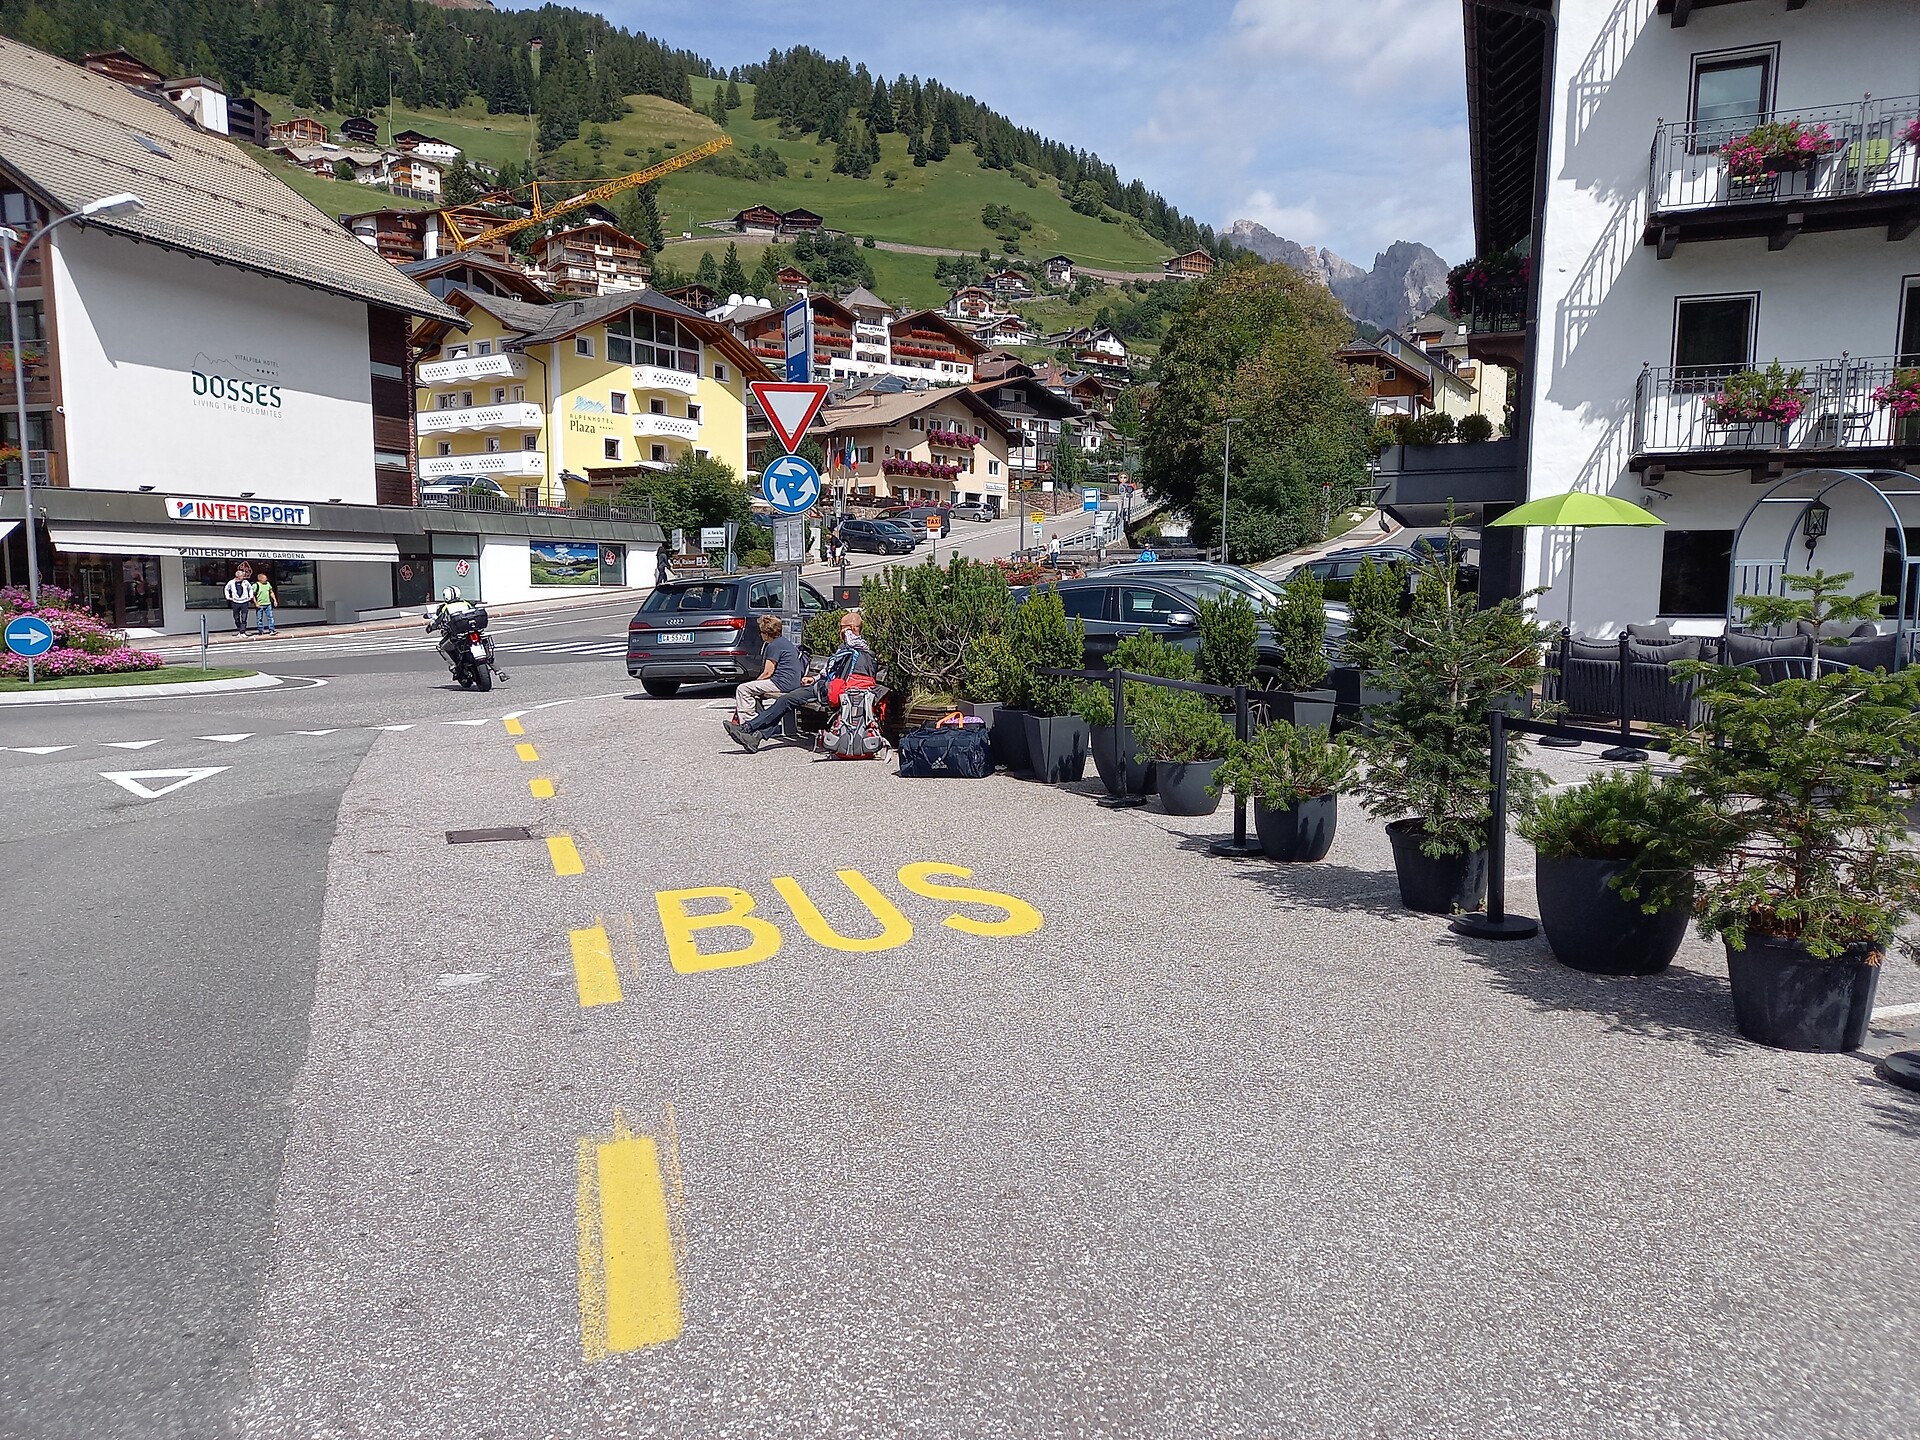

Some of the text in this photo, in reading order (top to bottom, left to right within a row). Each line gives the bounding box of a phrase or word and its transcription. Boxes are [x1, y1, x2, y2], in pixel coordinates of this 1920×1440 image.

[263, 360, 279, 368] HOTEL
[191, 370, 282, 408] DOSSES
[193, 399, 282, 418] LIVING THE DOLOMITES
[569, 413, 614, 424] ALPENHOTEL
[570, 420, 596, 434] Plaza
[196, 502, 304, 523] INTERSPORT
[188, 548, 249, 558] INTERSPORT
[655, 861, 1043, 974] BUS
